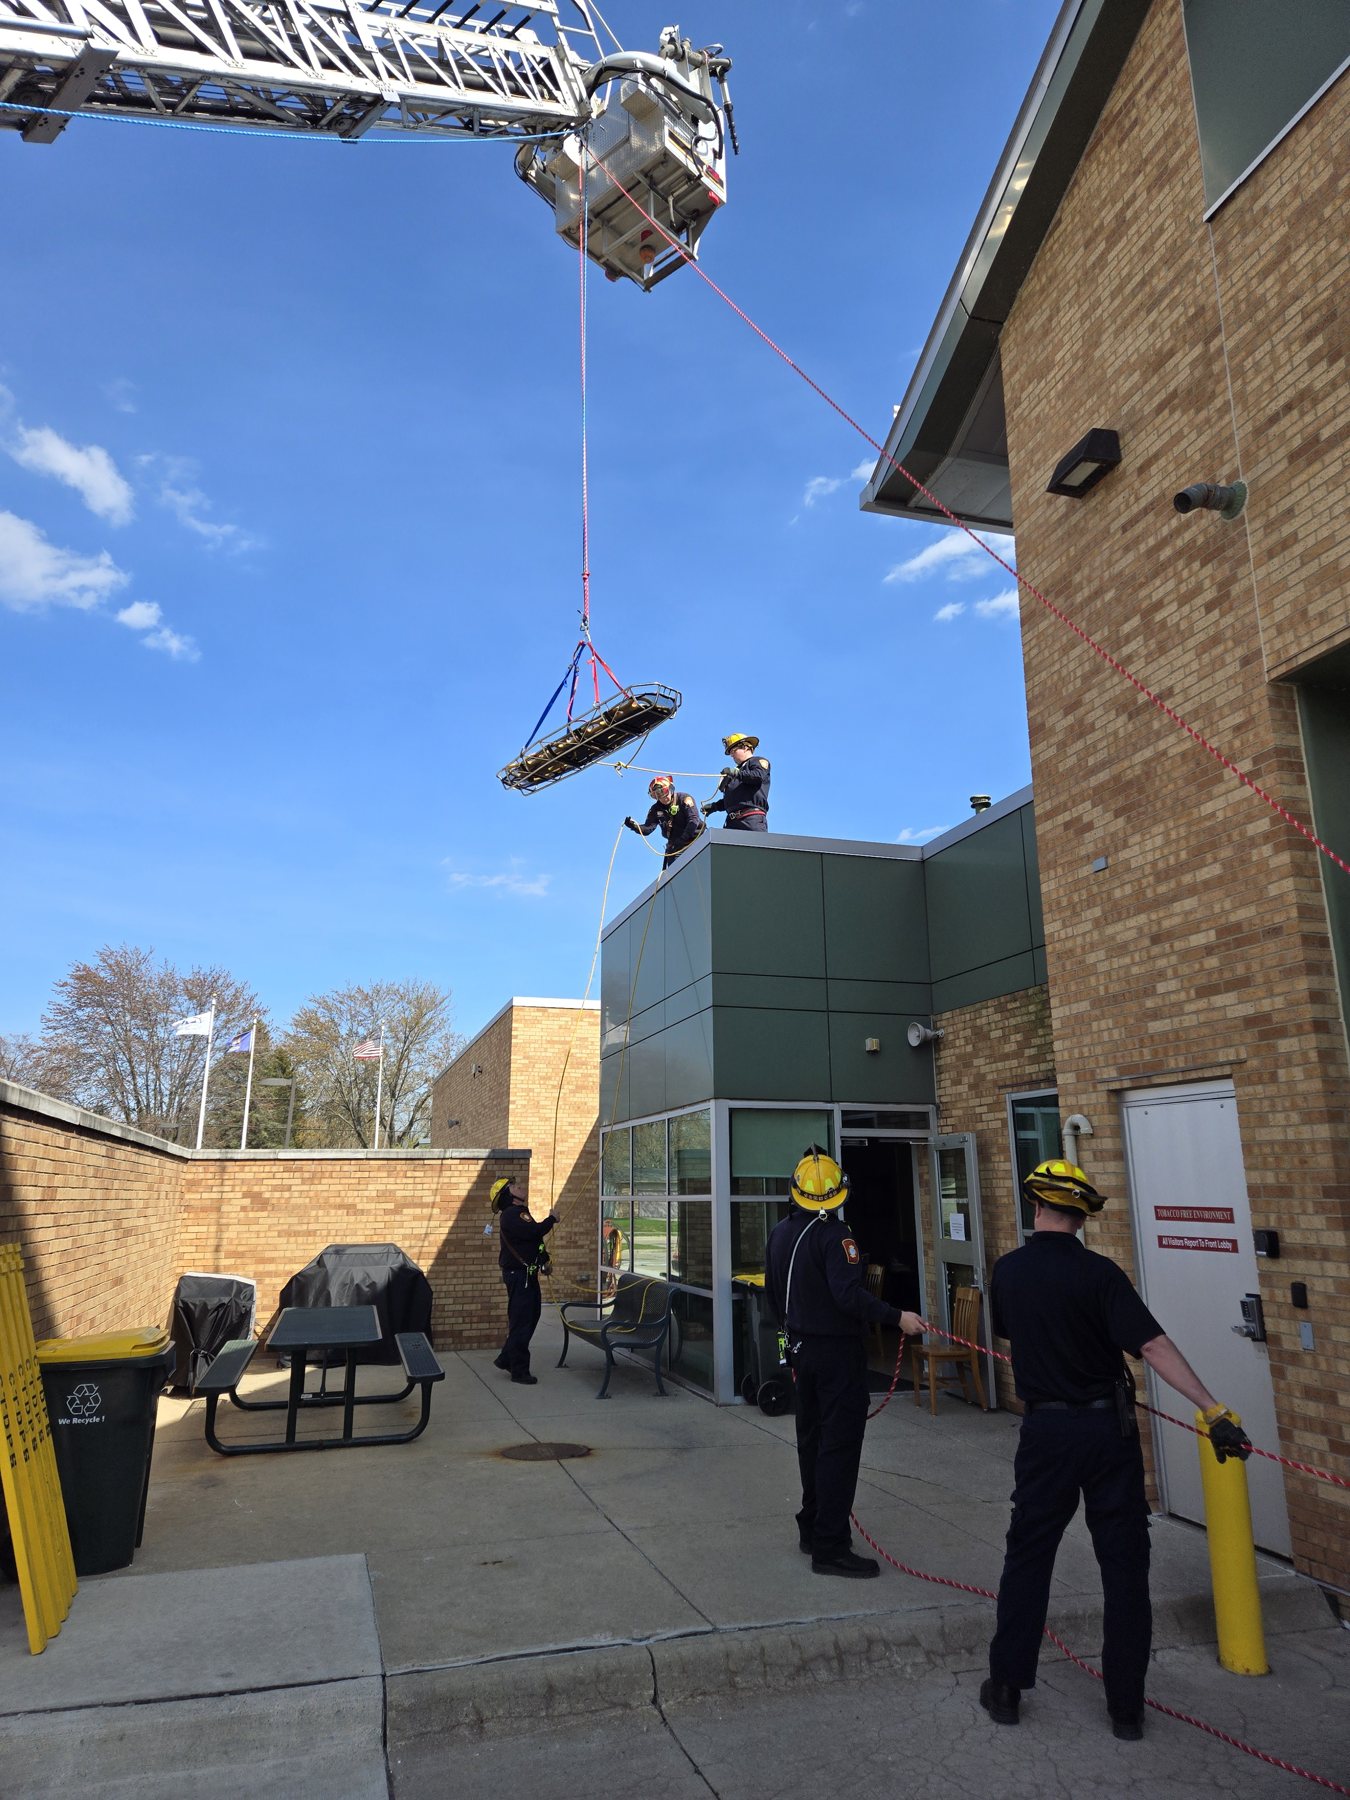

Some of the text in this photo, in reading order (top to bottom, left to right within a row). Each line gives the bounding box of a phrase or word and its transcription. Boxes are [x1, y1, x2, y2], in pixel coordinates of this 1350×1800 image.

[1157, 1208, 1231, 1220] TOBACCO FREE ENVIRONMENT
[1167, 1237, 1184, 1247] Visitors
[1184, 1238, 1199, 1248] Report
[1198, 1239, 1205, 1248] To
[1205, 1239, 1217, 1249] Front
[1217, 1240, 1232, 1251] Lobby
[18, 1363, 38, 1452] CTDPS
[9, 1372, 30, 1463] CTDPS
[72, 1416, 100, 1425] Recycle
